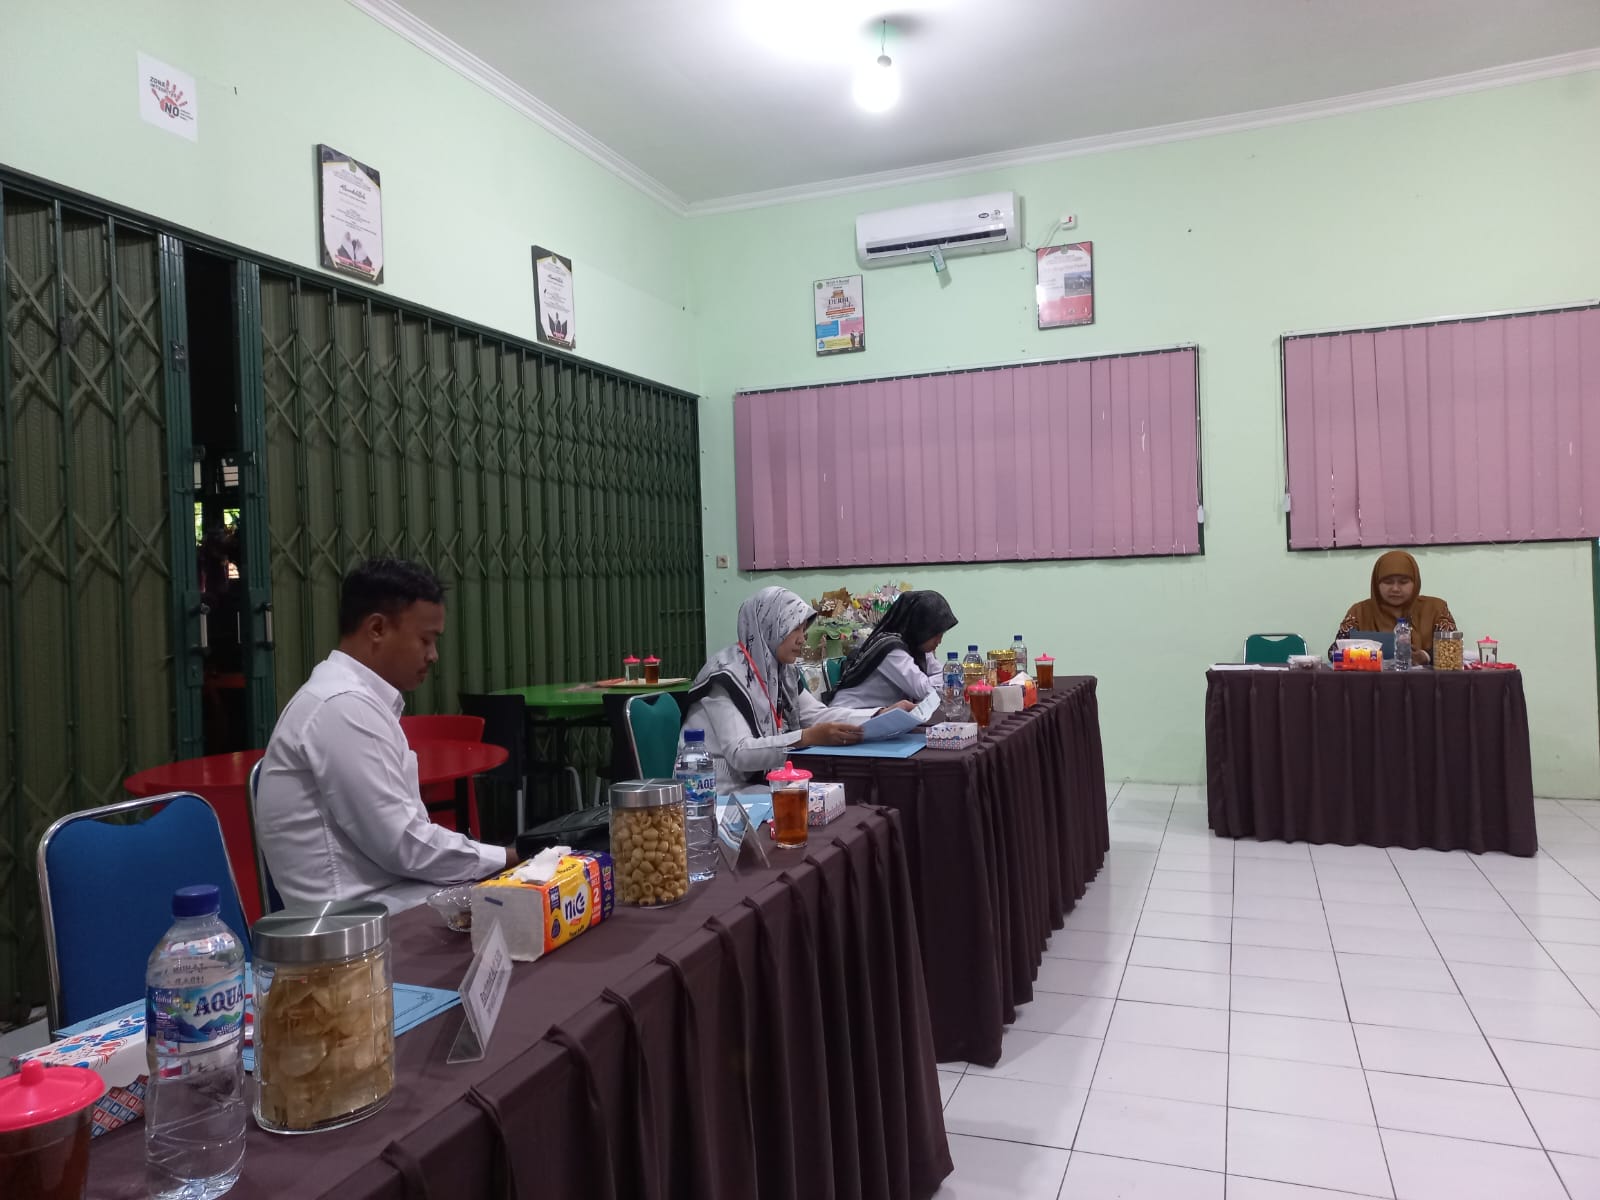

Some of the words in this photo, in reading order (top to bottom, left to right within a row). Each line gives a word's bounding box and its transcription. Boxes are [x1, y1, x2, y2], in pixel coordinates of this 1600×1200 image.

[164, 102, 179, 117] NO
[593, 888, 600, 903] 2
[193, 983, 244, 1017] AQUA
